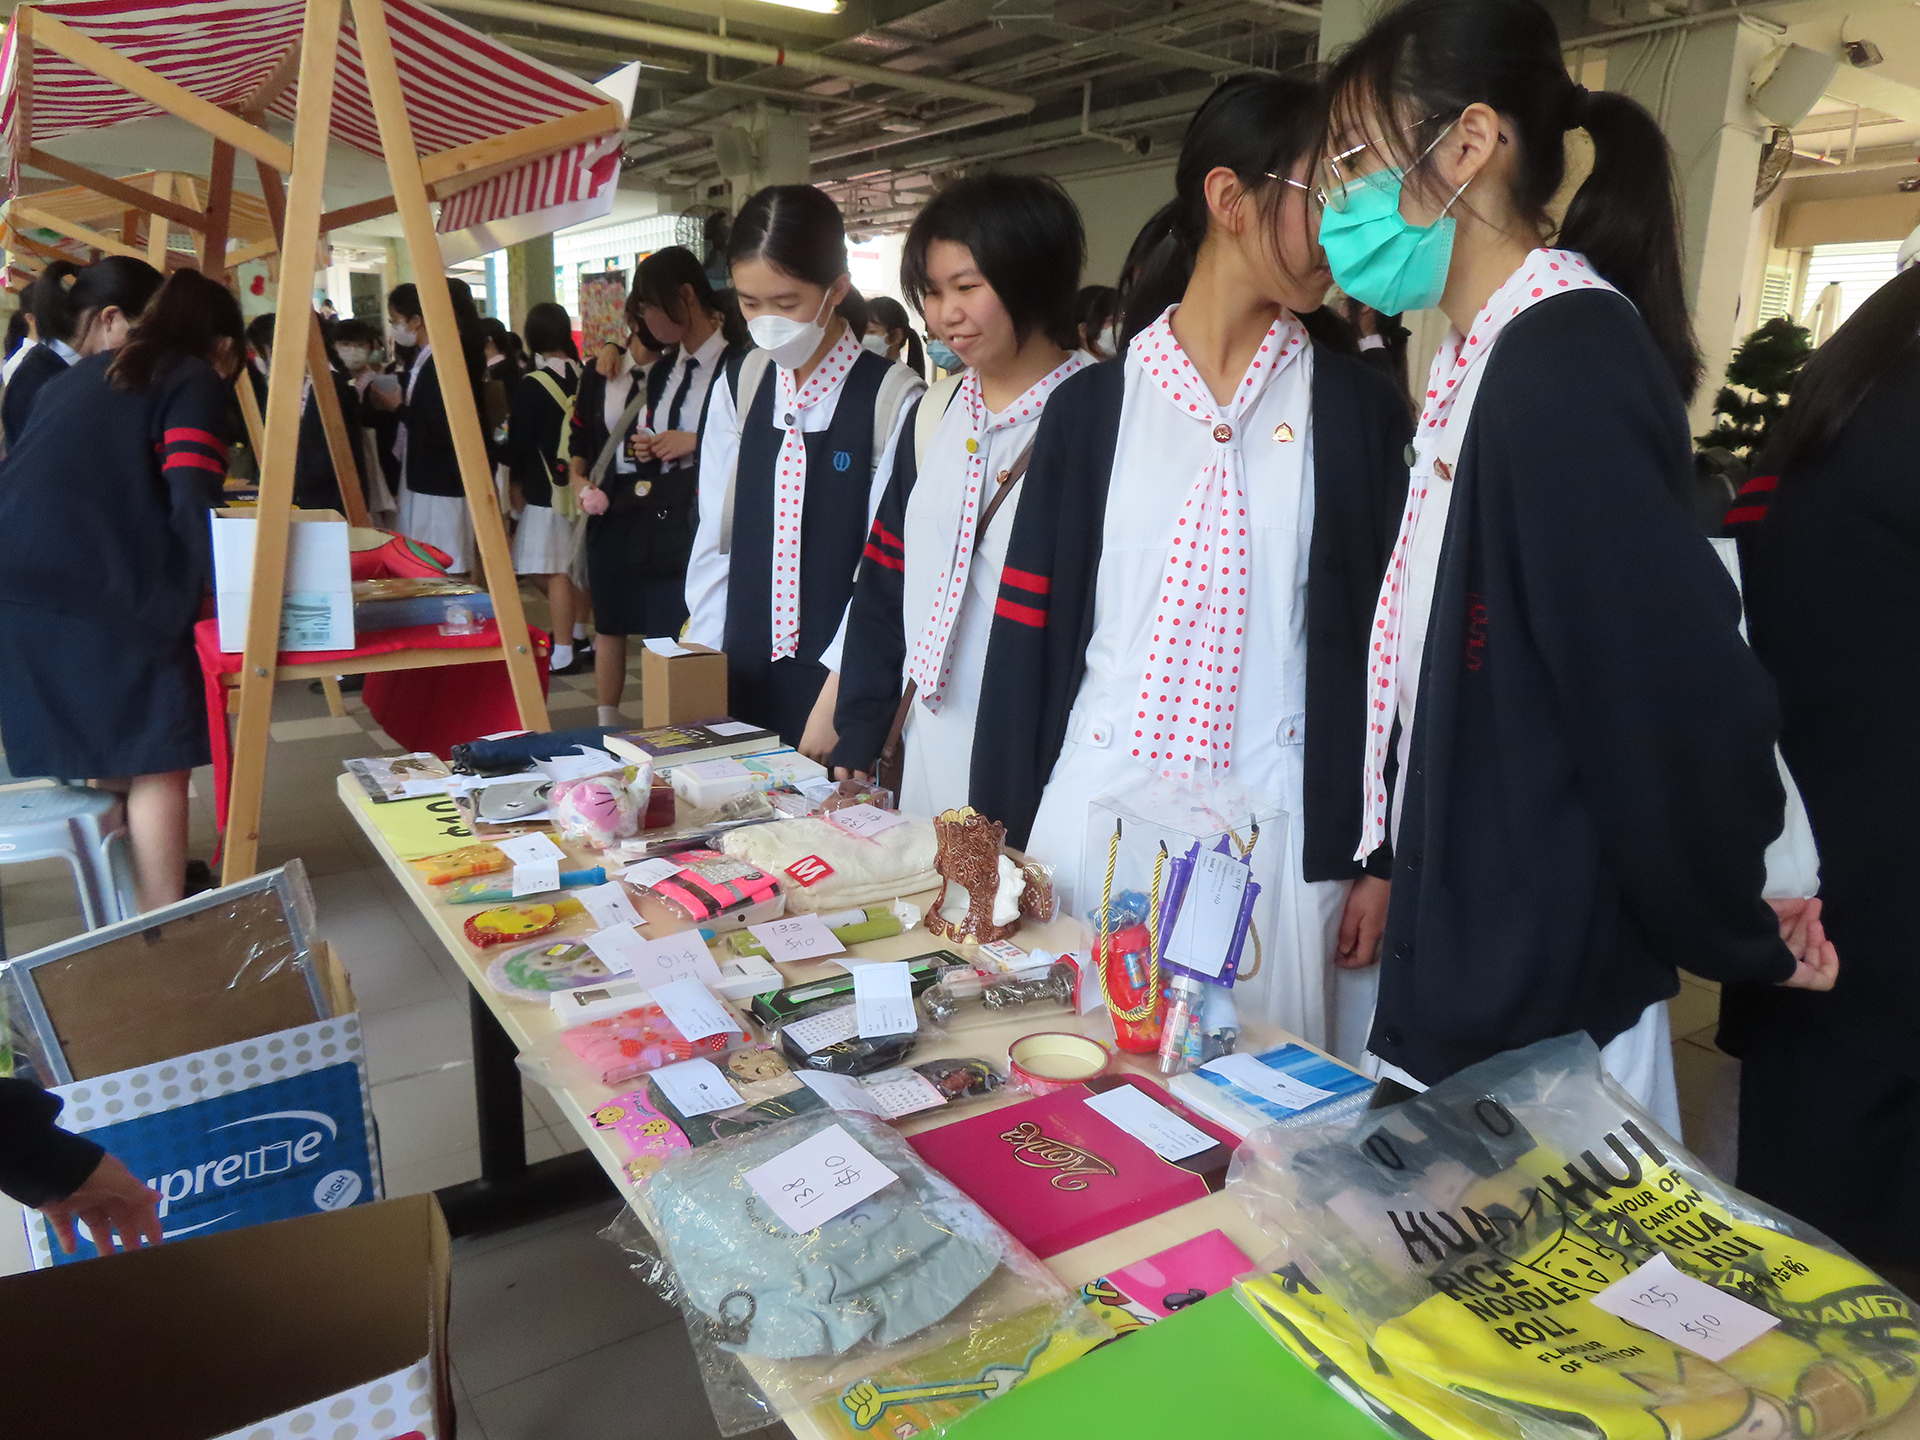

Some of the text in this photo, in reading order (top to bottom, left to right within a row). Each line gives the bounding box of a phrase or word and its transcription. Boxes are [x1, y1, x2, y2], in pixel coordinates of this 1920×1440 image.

[771, 922, 803, 935] 133
[784, 937, 815, 950] $10
[656, 948, 698, 969] $10
[825, 1155, 861, 1188] $10
[998, 1120, 1118, 1192] Wonka
[320, 1173, 350, 1206] HIGH
[782, 1177, 824, 1209] 138
[1387, 1120, 1669, 1264] HUA HUI
[1658, 1169, 1682, 1192] OF
[1639, 1189, 1703, 1230] CANTON
[1656, 1211, 1733, 1250] HUA
[1692, 1236, 1765, 1268] HUI
[1428, 1258, 1529, 1302] RICE
[1463, 1280, 1581, 1322] NOODLE
[1630, 1284, 1679, 1309] 135
[1495, 1315, 1578, 1349] ROLL
[1679, 1314, 1722, 1341] $10
[1537, 1340, 1607, 1364] FLAVOUR
[1560, 1345, 1646, 1374] OF CANTON
